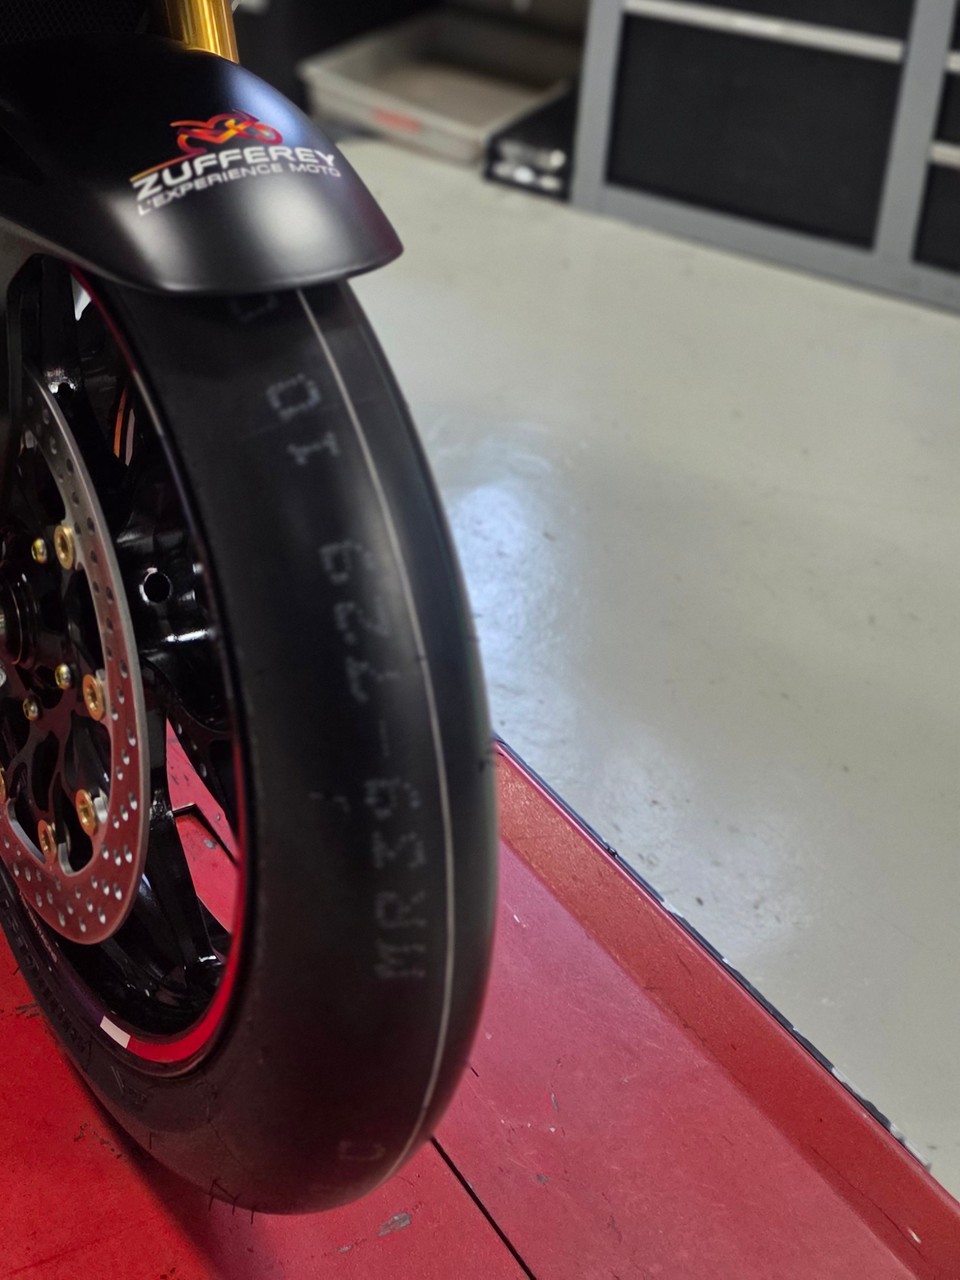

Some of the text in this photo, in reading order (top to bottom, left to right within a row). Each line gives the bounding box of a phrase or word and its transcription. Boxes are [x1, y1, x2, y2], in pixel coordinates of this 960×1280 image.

[132, 145, 337, 203] ZUFFEREY
[137, 162, 342, 216] L'EXPERIENCE MOTO
